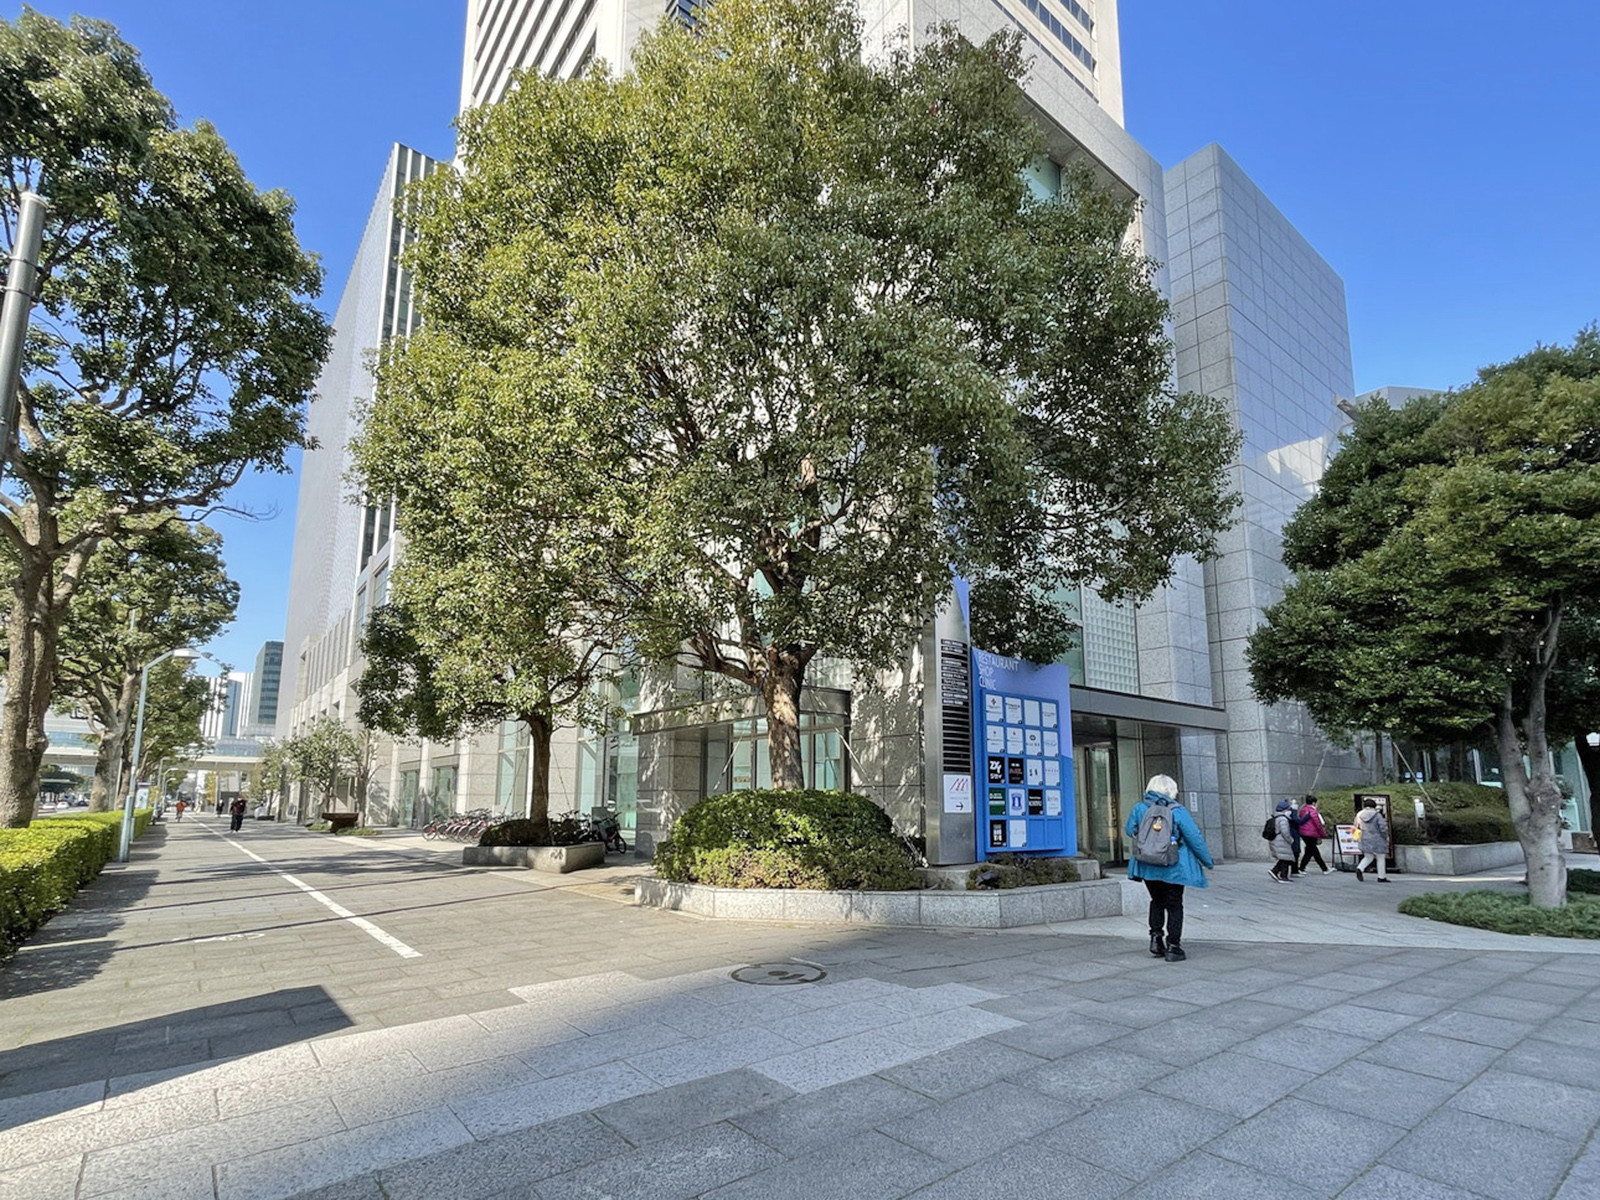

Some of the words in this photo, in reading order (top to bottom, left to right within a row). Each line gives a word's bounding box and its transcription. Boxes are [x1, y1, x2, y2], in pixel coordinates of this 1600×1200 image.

[978, 651, 1019, 672] RESTAURANT
[978, 664, 994, 677] SHOP
[978, 675, 996, 690] CLINIC
